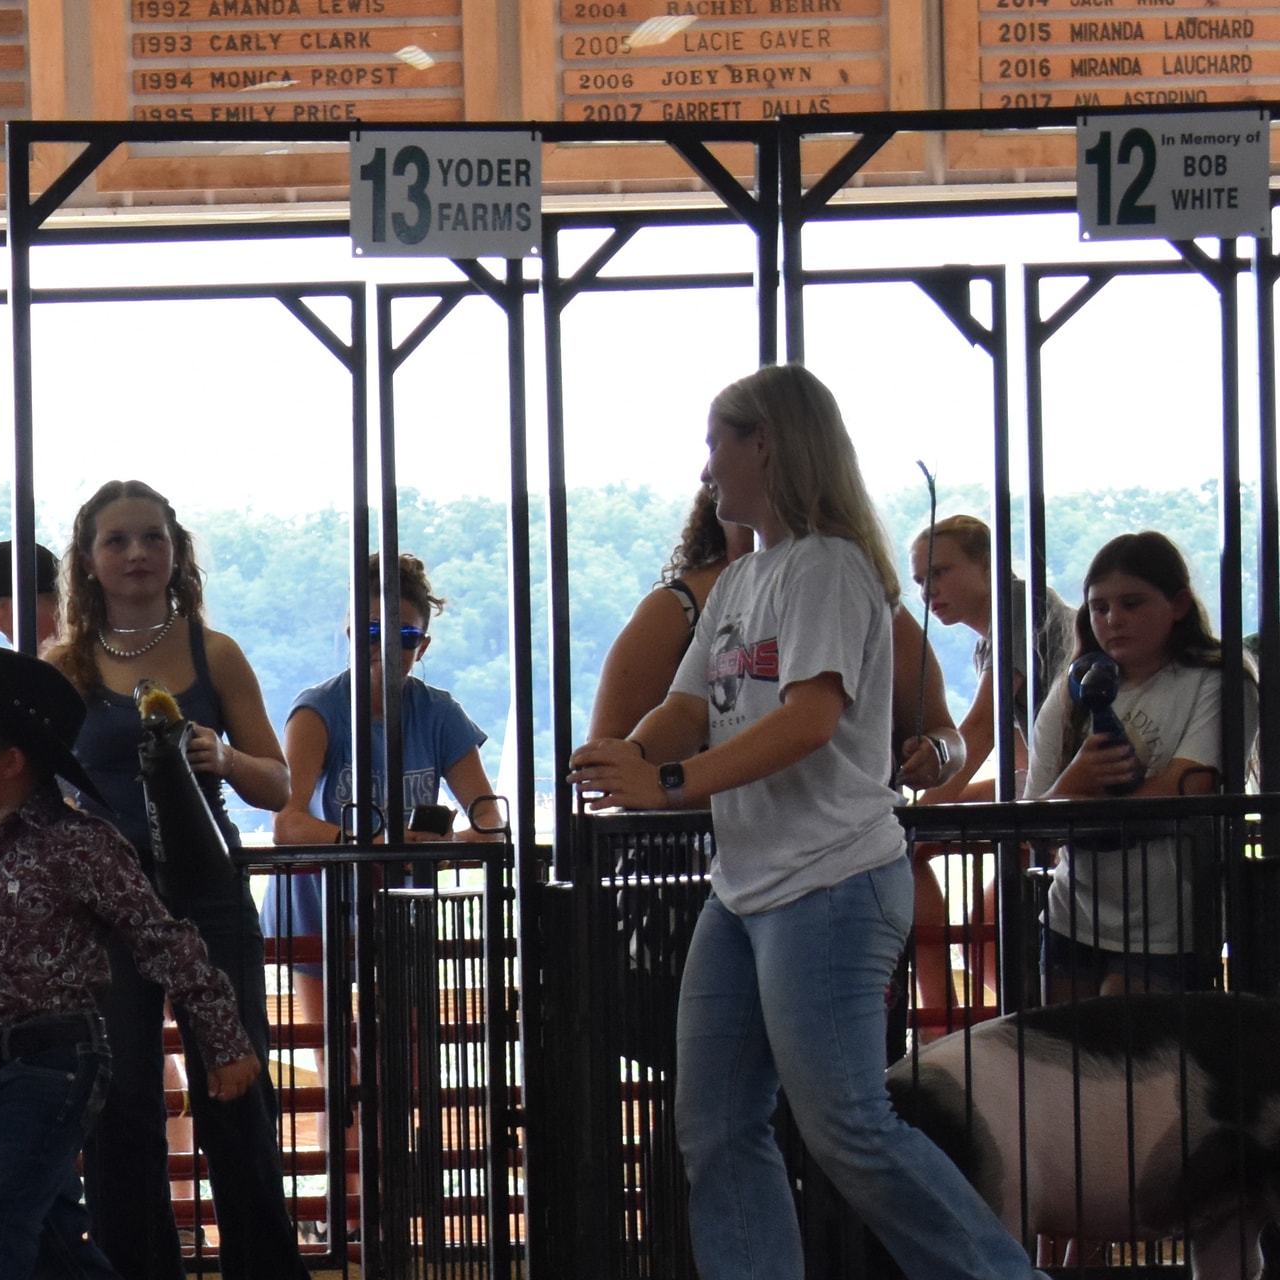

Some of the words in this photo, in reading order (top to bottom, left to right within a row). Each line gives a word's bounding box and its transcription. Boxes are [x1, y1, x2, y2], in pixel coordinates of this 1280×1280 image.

[138, 0, 192, 18] 1992
[208, 0, 301, 17] AMANDA
[319, 0, 385, 14] LEWIS
[575, 2, 628, 18] 2004
[666, 0, 758, 16] RACHEL
[765, 0, 844, 13] BERRY
[139, 35, 193, 53] 1993
[210, 33, 282, 51] CARLY
[300, 31, 372, 49] CLARK
[999, 23, 1052, 42] 2015
[1070, 21, 1144, 41] MIRANDA
[1165, 20, 1254, 39] LAUCHARD
[575, 36, 632, 56] 2005
[684, 32, 743, 52] LACIE
[760, 29, 831, 50] GAVER
[1000, 59, 1052, 78] 2016
[1071, 57, 1142, 77] MIRANDA
[1163, 55, 1252, 75] LAUCHARD
[141, 71, 194, 89] 1994
[211, 70, 295, 87] MONICA
[312, 67, 399, 85] PROPST
[579, 74, 634, 90] 2006
[662, 71, 718, 86] JOEY
[730, 67, 812, 85] BROWN
[584, 103, 642, 122] 2007
[663, 101, 742, 121] GARRETT
[763, 99, 831, 119] DALLAS
[1001, 94, 1052, 108] 2017
[1074, 93, 1100, 108] AVA
[142, 109, 194, 121] 1995
[211, 107, 276, 121] EMILY
[294, 104, 357, 121] PRICE
[1161, 134, 1175, 145] In
[1180, 132, 1240, 147] Memory
[1246, 131, 1261, 143] of
[437, 158, 532, 187] YODER
[1085, 127, 1156, 225] 12
[1184, 155, 1227, 177] BOB
[360, 145, 431, 245] 13
[1172, 188, 1238, 210] WHITE
[438, 202, 532, 231] FARMS
